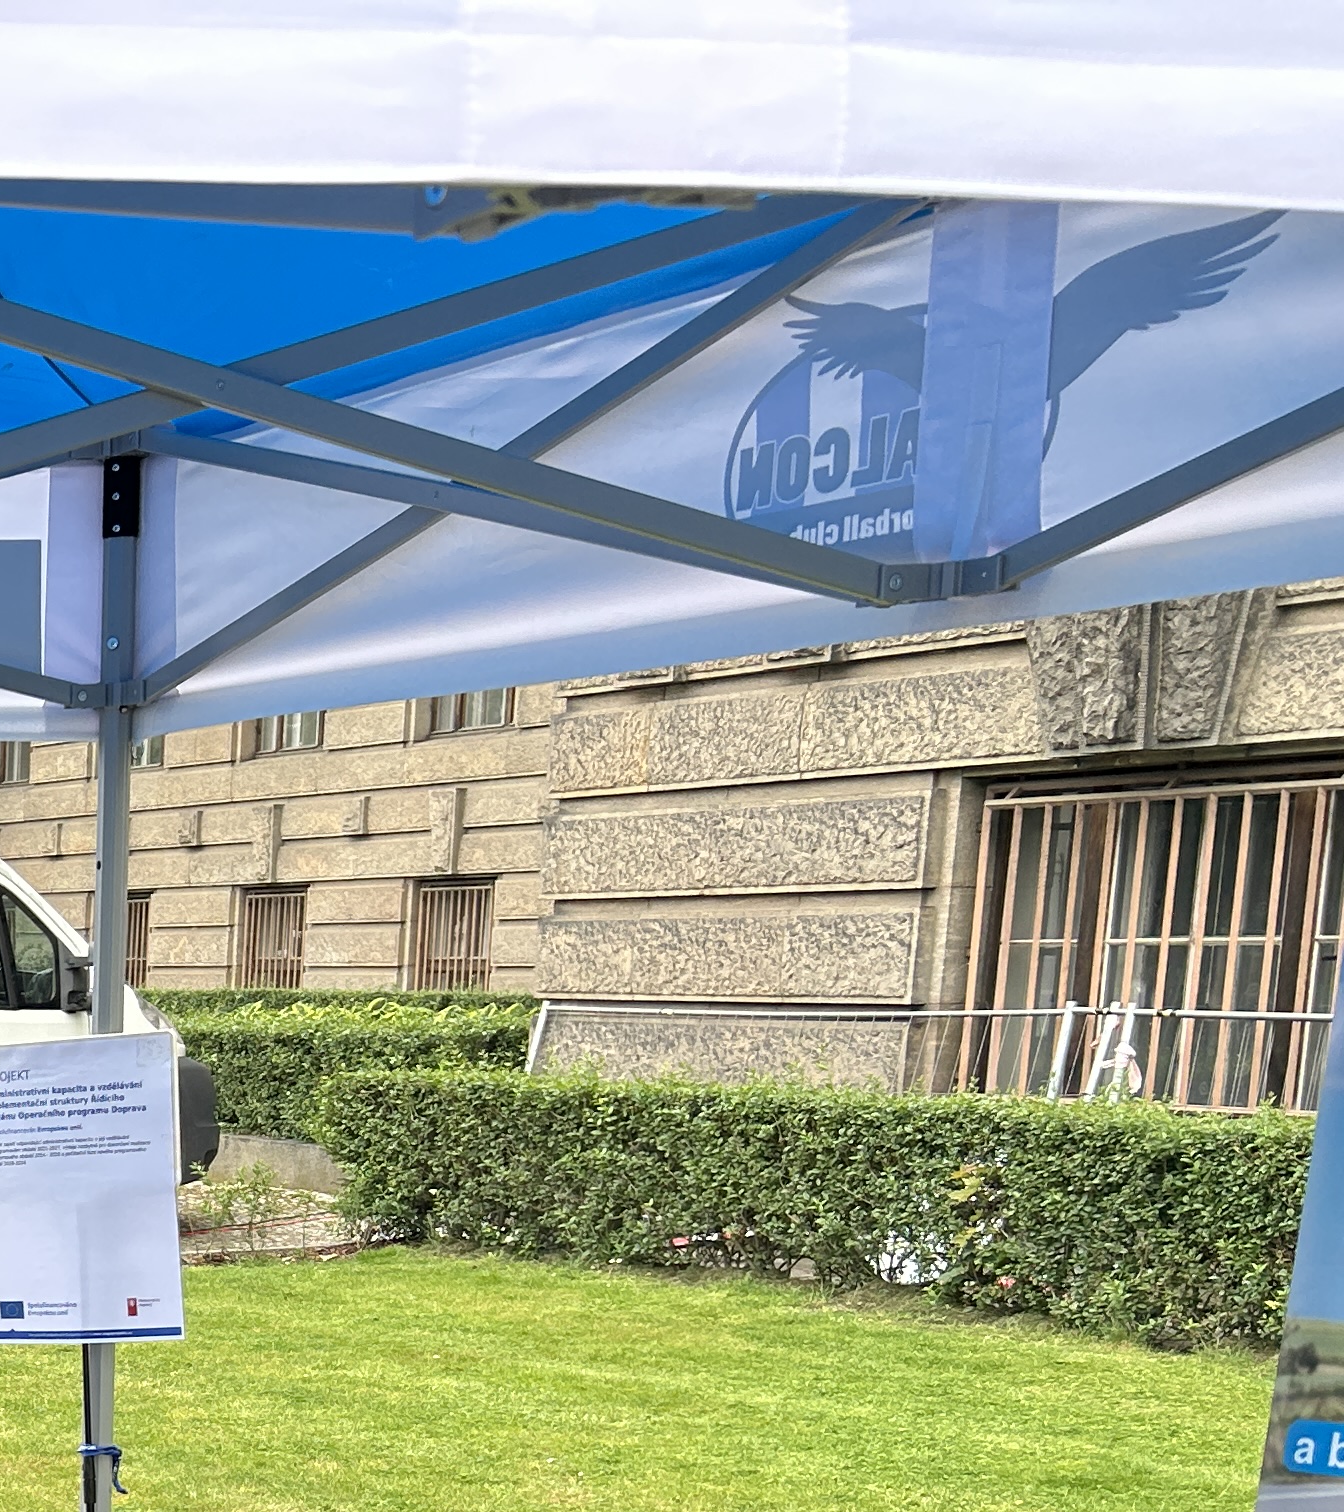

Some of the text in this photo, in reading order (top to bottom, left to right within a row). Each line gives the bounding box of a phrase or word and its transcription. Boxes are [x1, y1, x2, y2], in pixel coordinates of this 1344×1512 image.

[52, 1085, 88, 1096] kapacita
[50, 1096, 88, 1106] struktury
[67, 1107, 109, 1118] programu
[111, 1104, 147, 1114] Doprava
[1293, 1436, 1314, 1466] a
